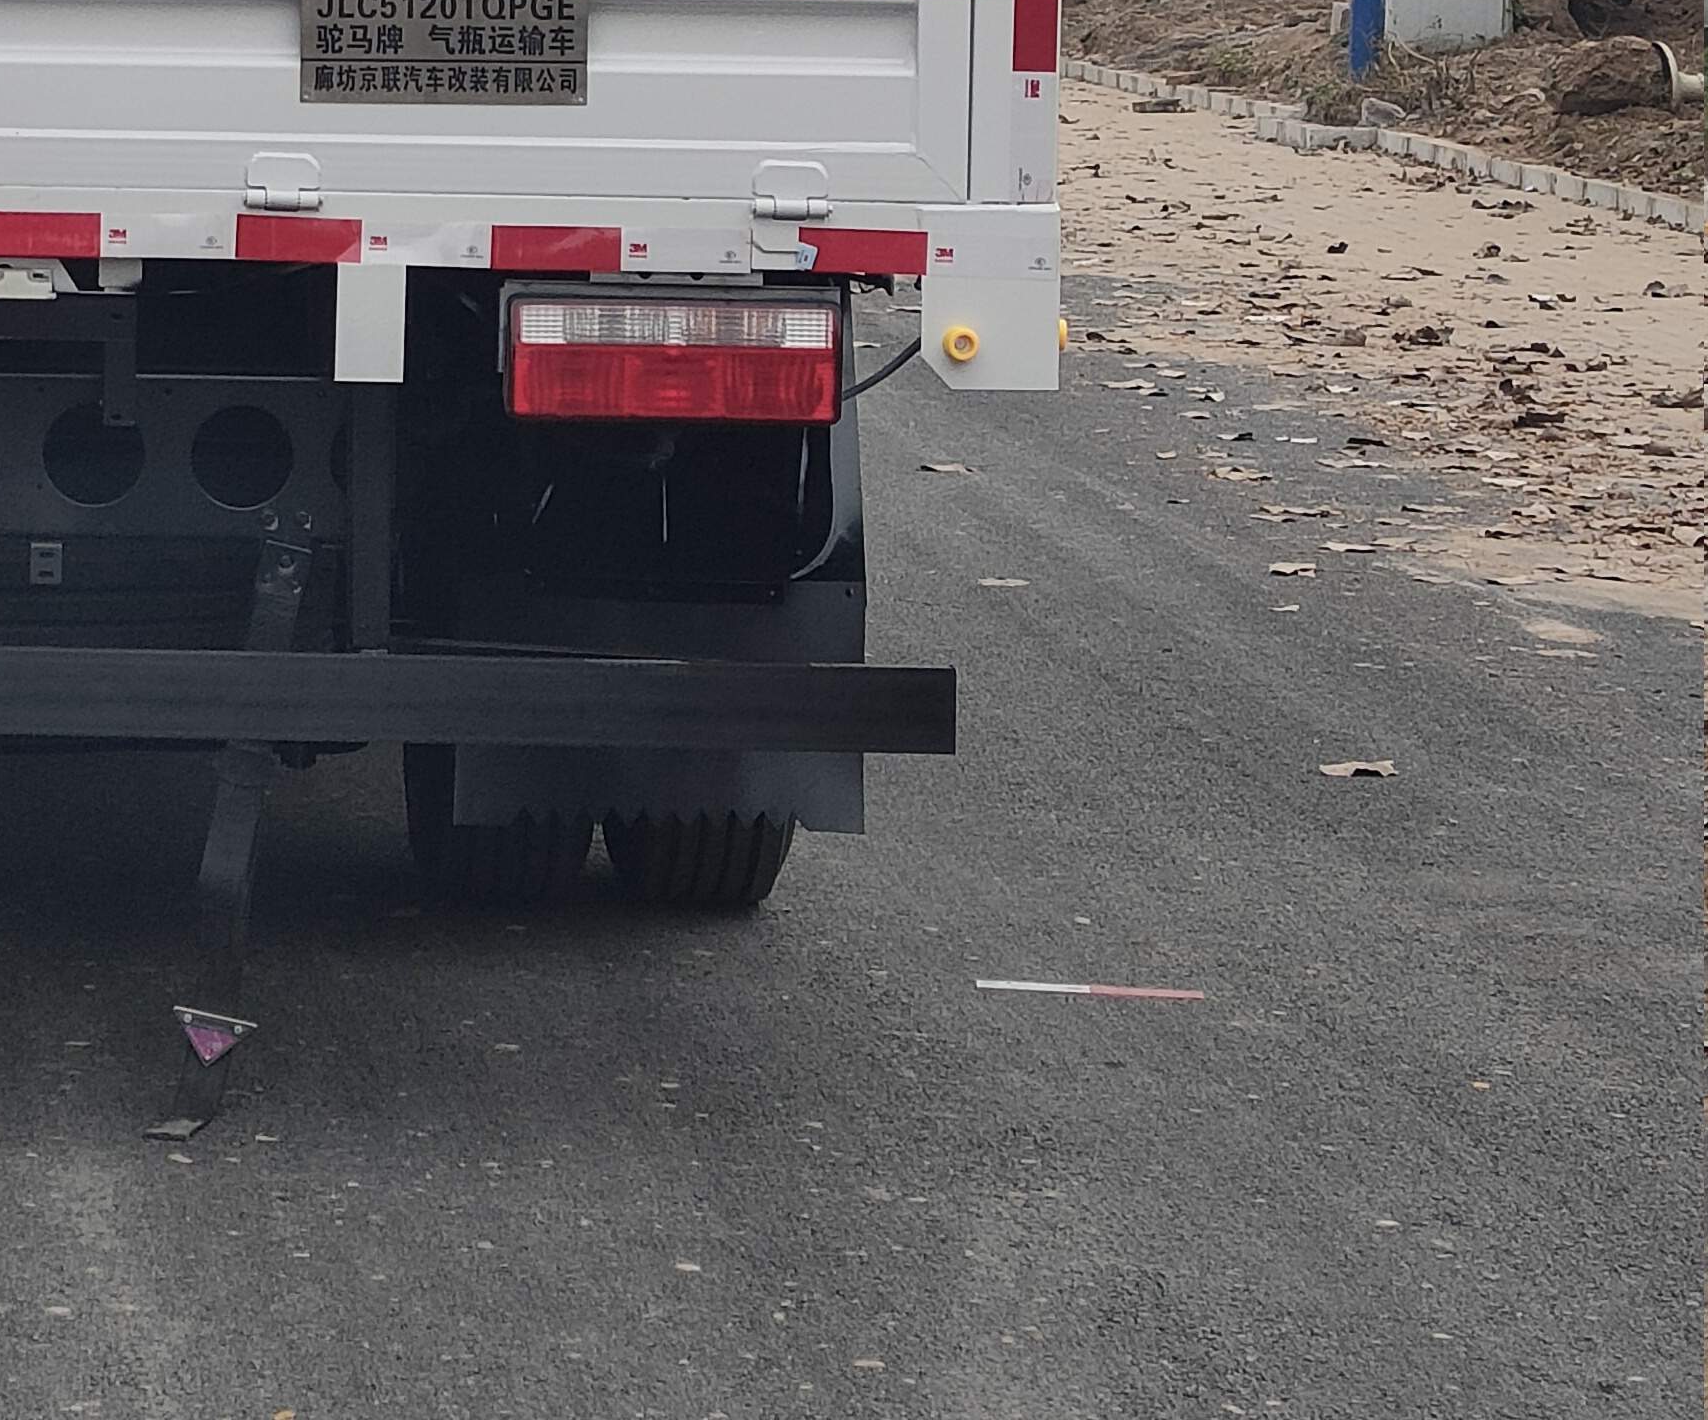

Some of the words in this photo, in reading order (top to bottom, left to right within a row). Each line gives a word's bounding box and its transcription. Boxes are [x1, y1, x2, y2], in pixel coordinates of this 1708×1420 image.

[316, 24, 404, 55] 驼马牌
[428, 25, 575, 56] 气瓶运输车
[314, 65, 578, 94] 廊坊京联汽车改装有限公司
